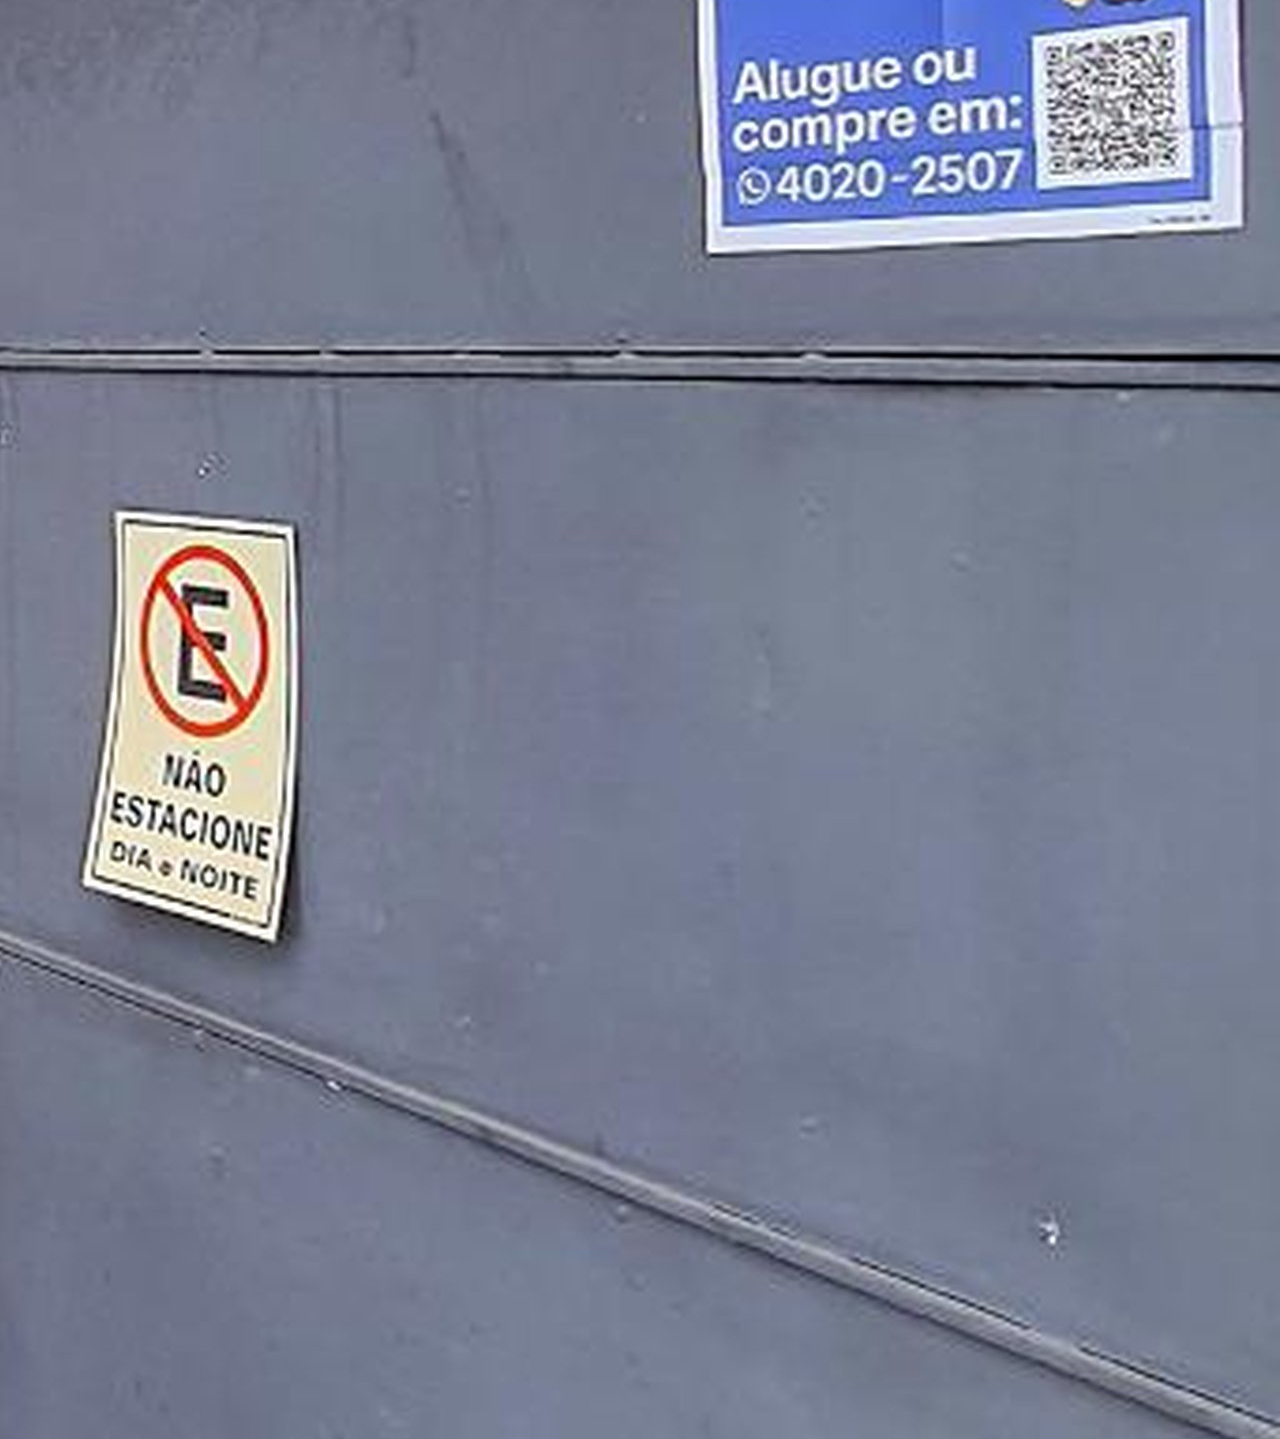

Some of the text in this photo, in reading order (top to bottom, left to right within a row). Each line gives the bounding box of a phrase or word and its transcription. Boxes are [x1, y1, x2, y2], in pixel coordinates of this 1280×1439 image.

[732, 47, 977, 107] Alugue ou
[732, 94, 1023, 155] compre em:
[775, 148, 1024, 202] 4020-2507
[162, 750, 227, 798] NÃO
[110, 791, 273, 861] ESTACIONE
[110, 840, 152, 872] DIA
[180, 858, 259, 901] NOITE
